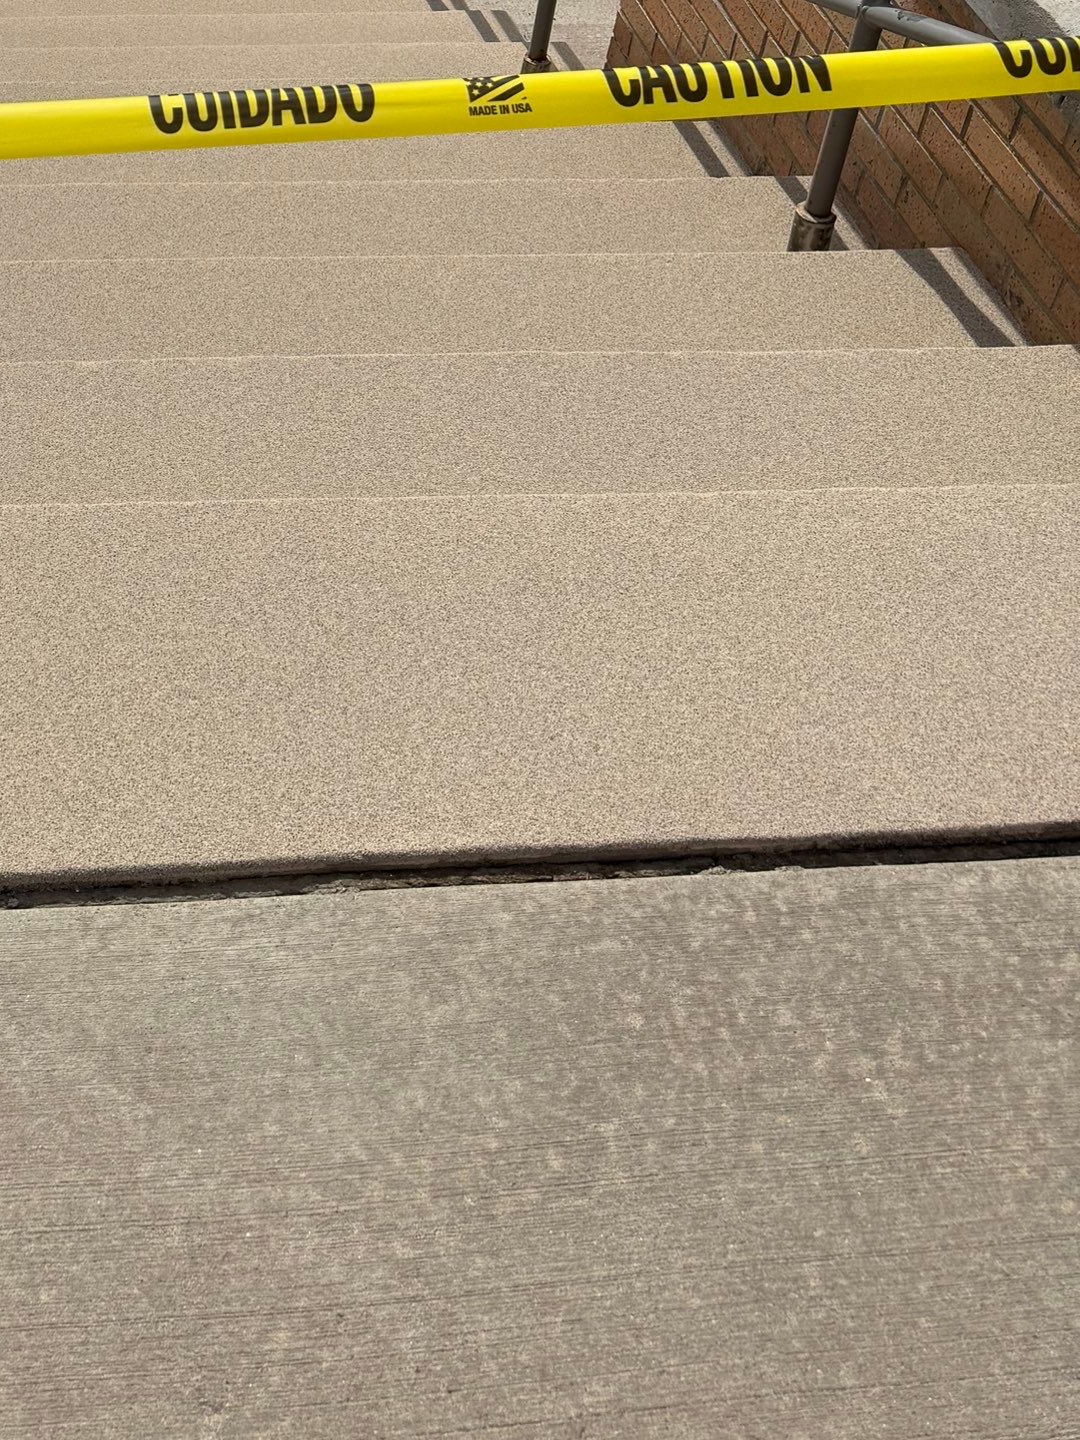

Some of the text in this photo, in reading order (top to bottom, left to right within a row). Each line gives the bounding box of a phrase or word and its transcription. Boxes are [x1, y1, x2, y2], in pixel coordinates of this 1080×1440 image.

[995, 36, 1080, 78] CUI
[602, 55, 831, 106] CAUTION
[148, 83, 375, 134] CUIDADO
[468, 103, 533, 116] MADE IN USA
